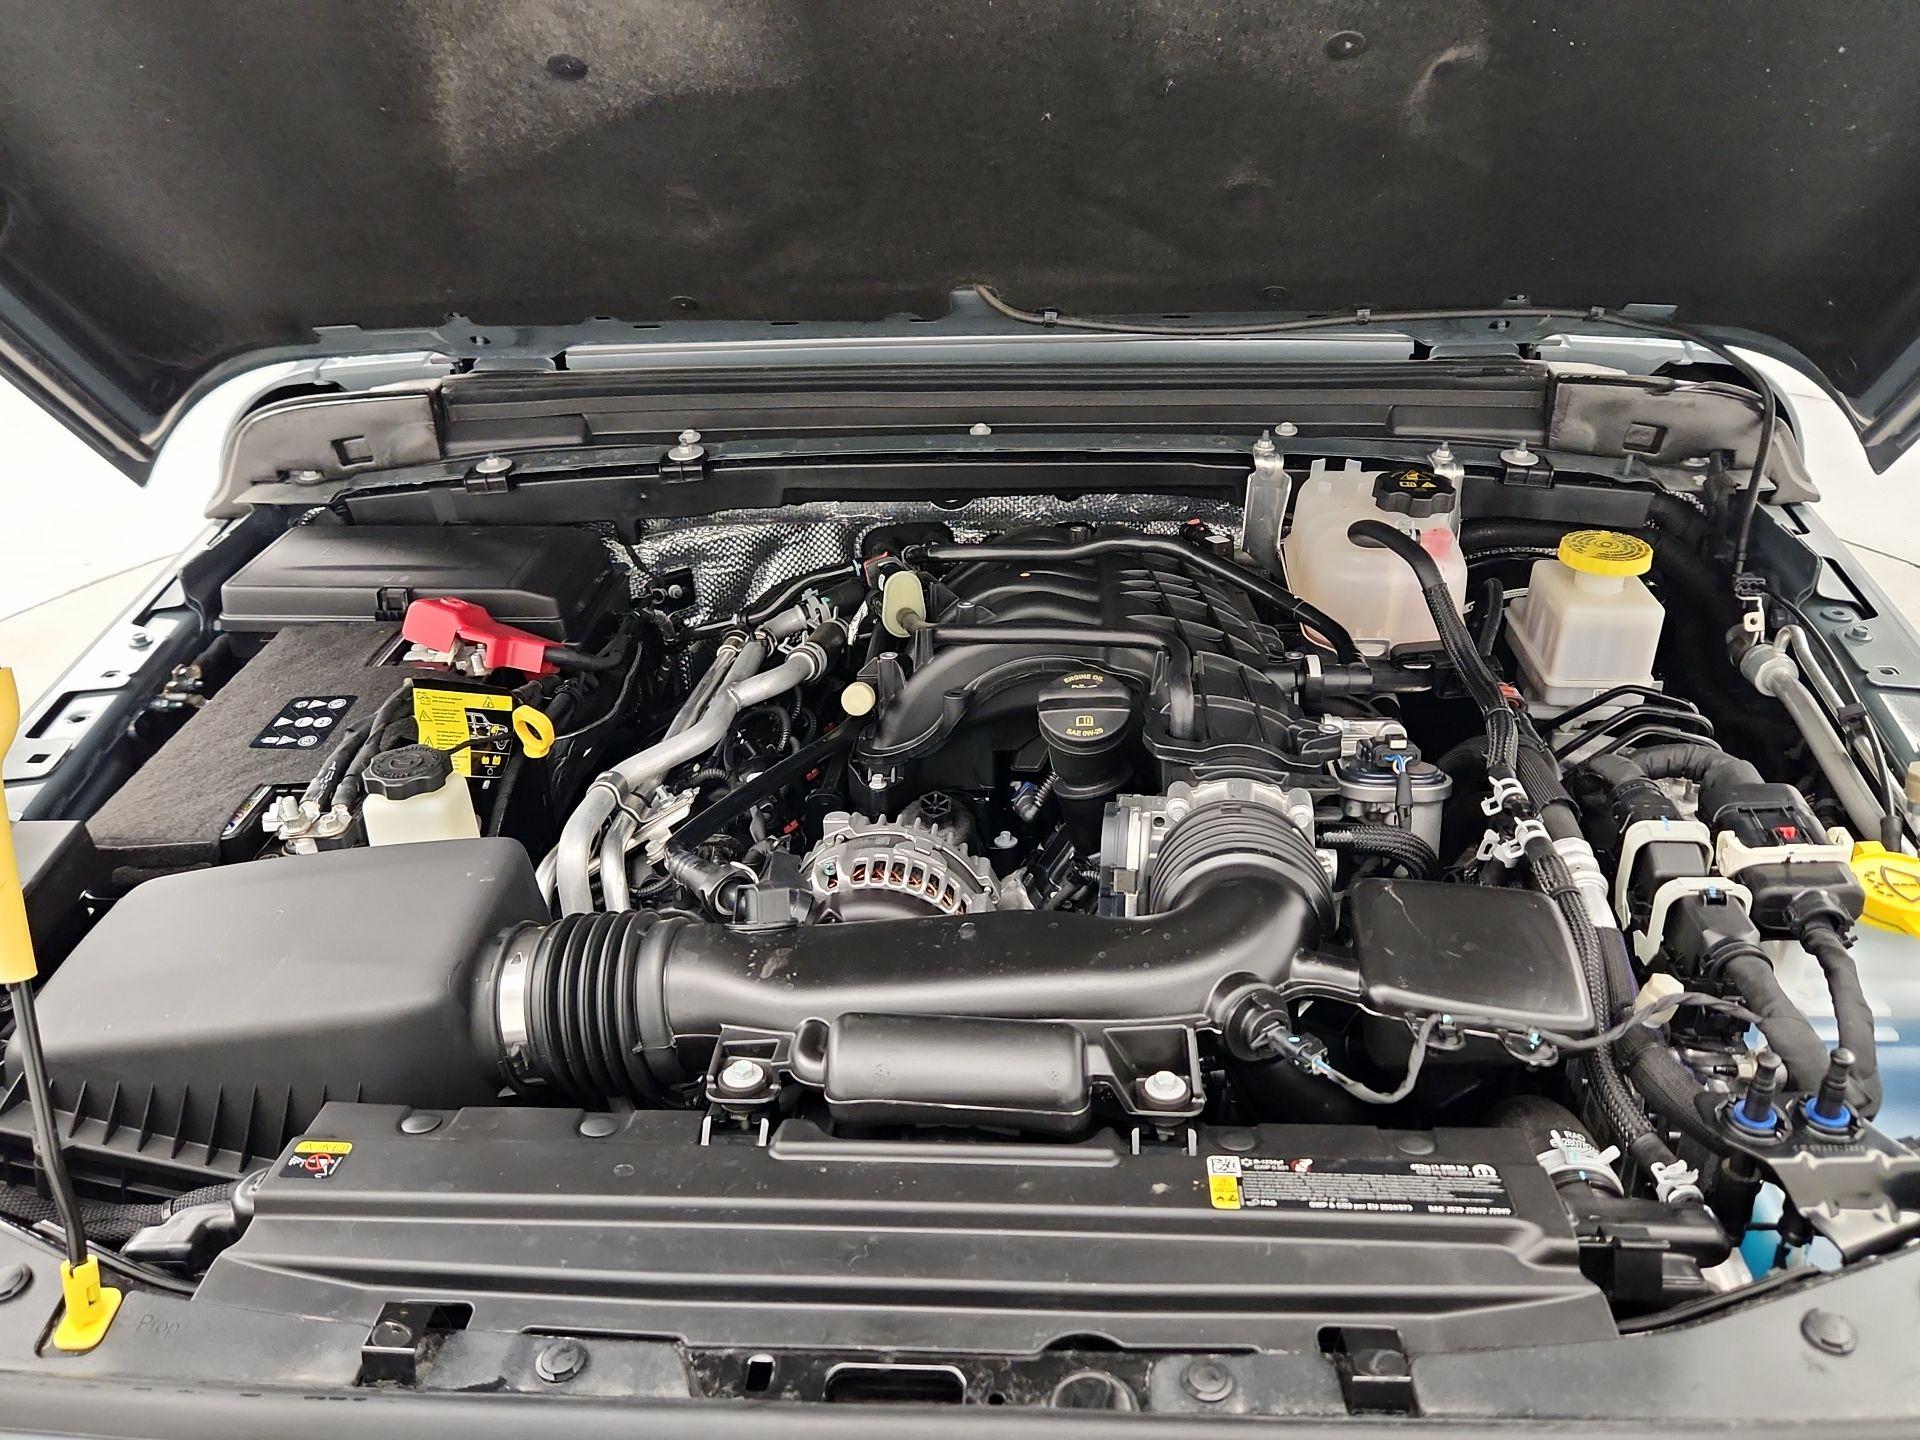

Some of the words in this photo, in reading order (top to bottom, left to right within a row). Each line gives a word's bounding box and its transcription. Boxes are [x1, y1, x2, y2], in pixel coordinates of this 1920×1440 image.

[1064, 674, 1091, 683] ENGINE
[1066, 728, 1081, 736] SAE
[1082, 728, 1103, 736] 0W-20
[1563, 1130, 1586, 1142] RAD
[136, 1313, 180, 1338] Prop
